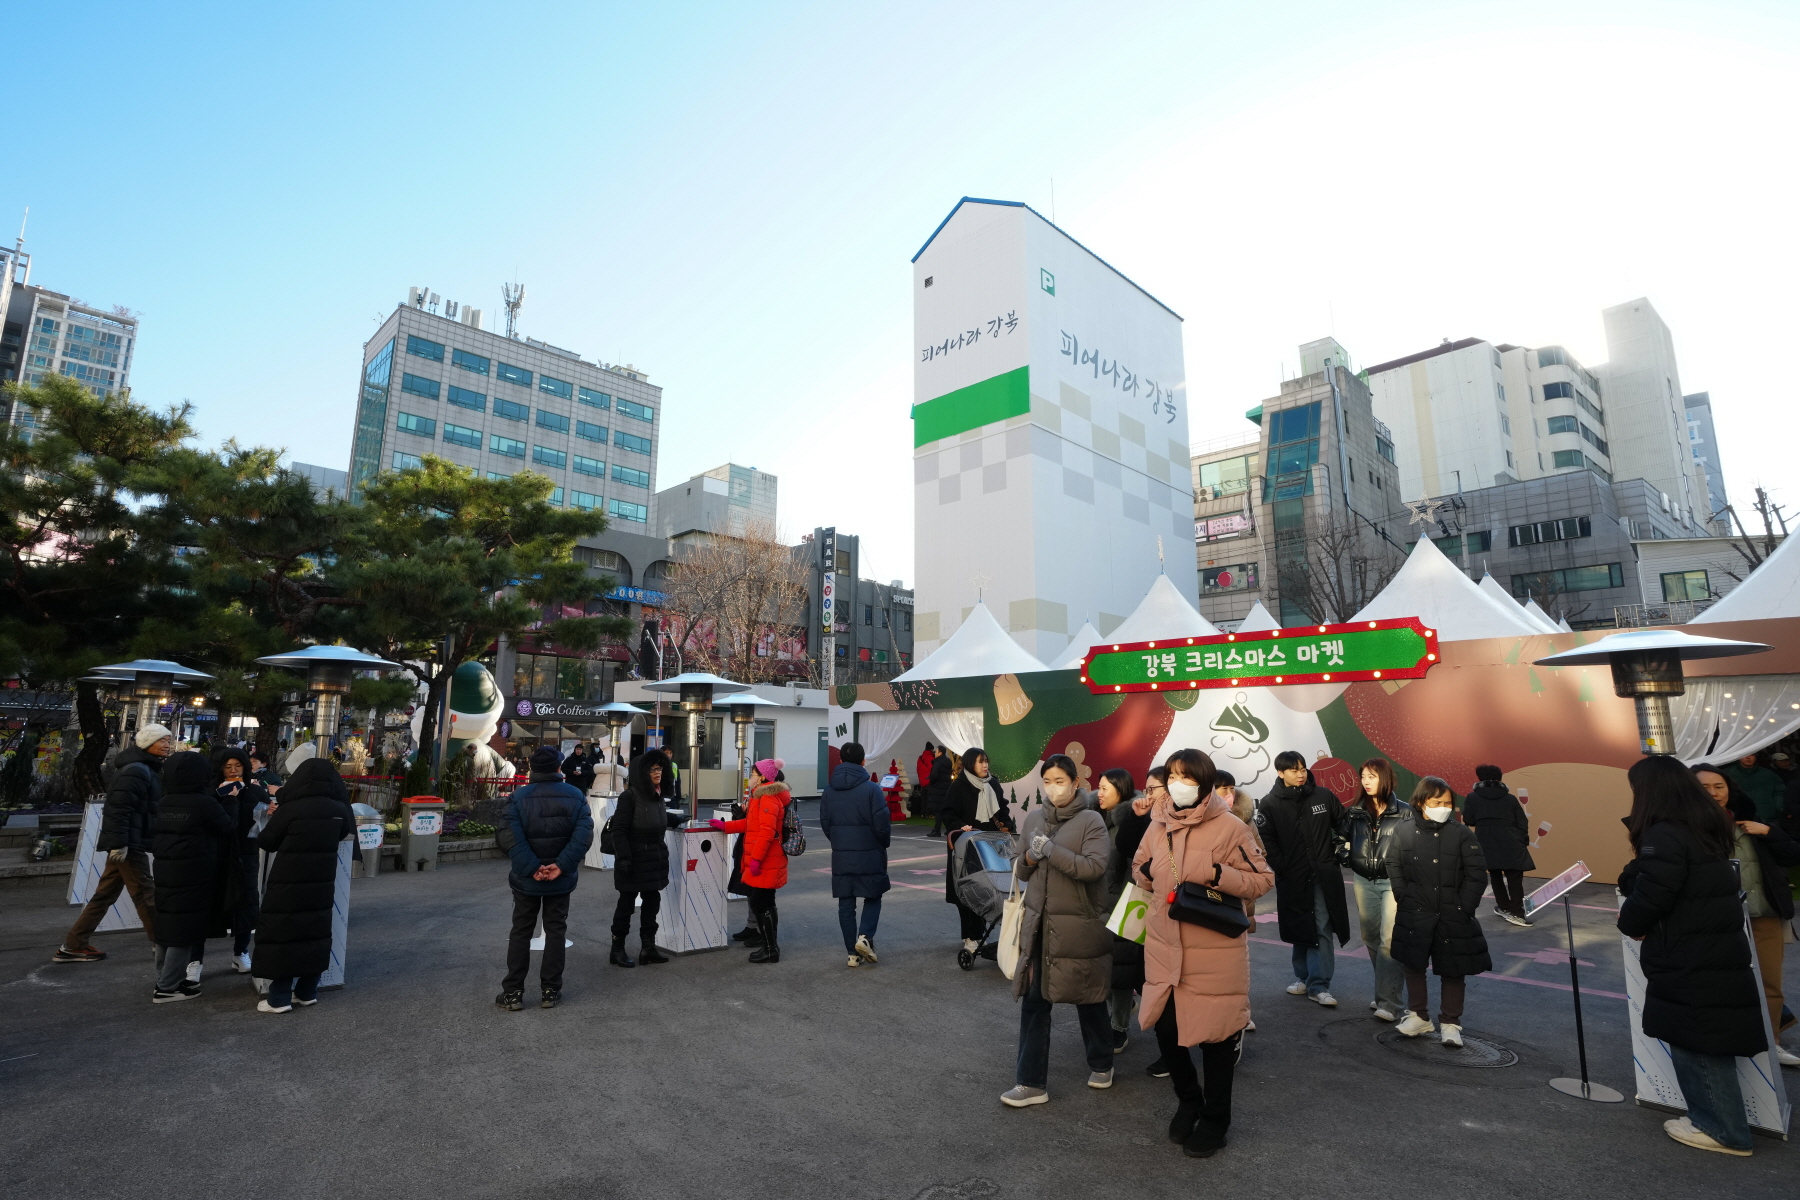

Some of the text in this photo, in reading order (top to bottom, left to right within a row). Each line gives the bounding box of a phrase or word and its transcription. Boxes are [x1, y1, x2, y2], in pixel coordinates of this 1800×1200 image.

[1042, 269, 1054, 292] P
[921, 309, 1019, 363] 피어나라 강북
[1060, 328, 1177, 424] 피어나라 강북
[825, 537, 833, 567] BAR
[1141, 640, 1345, 678] 강북 크리스마스 마켓
[534, 702, 555, 716] The
[557, 704, 591, 716] Coffee
[835, 722, 848, 738] IN
